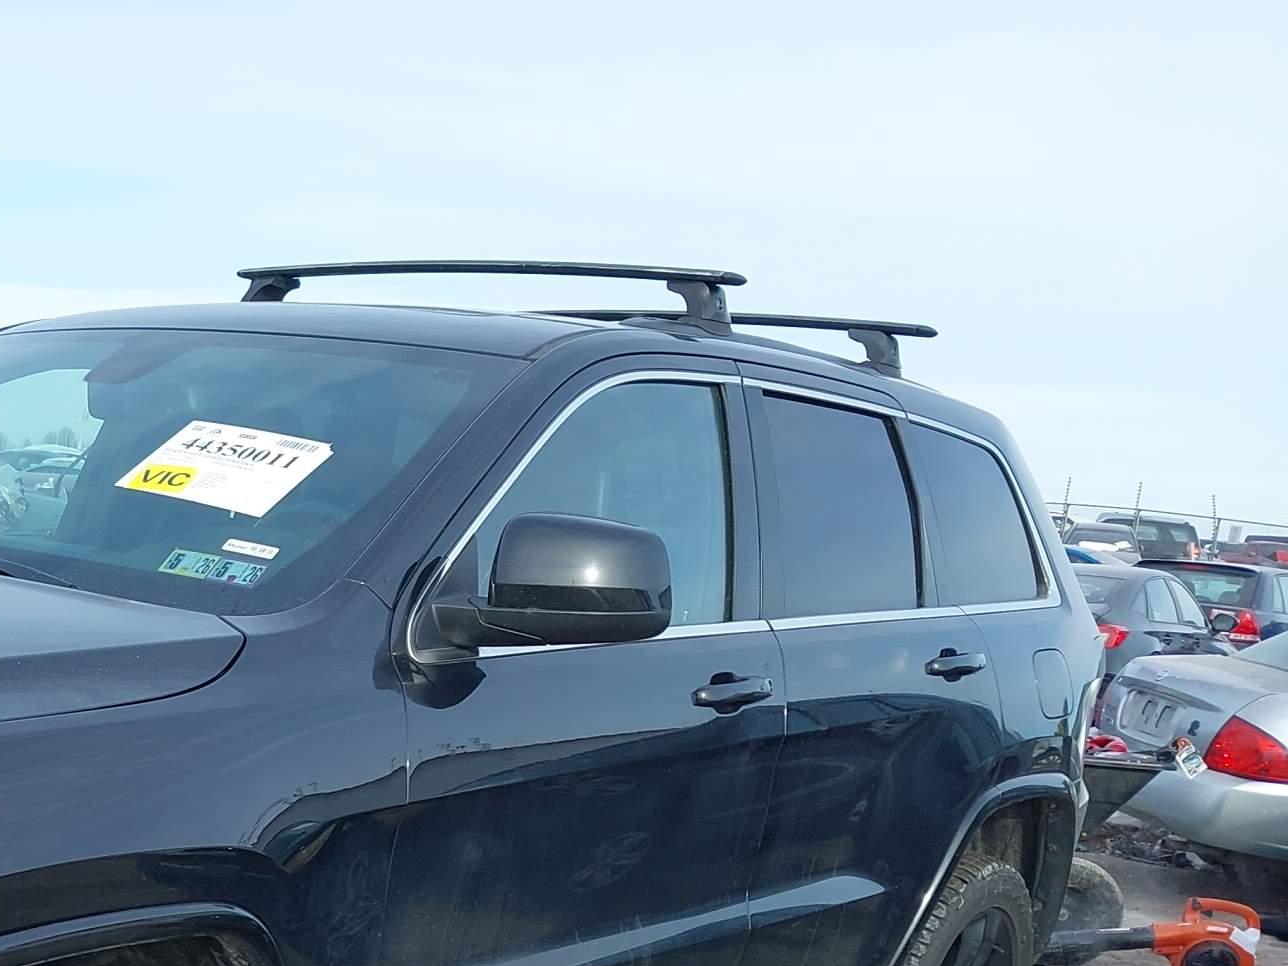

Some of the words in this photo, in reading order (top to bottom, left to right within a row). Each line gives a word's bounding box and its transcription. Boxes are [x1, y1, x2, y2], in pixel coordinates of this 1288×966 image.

[181, 437, 300, 469] 44350011
[142, 469, 191, 487] VIC
[195, 557, 215, 574] 26
[243, 566, 263, 583] 26
